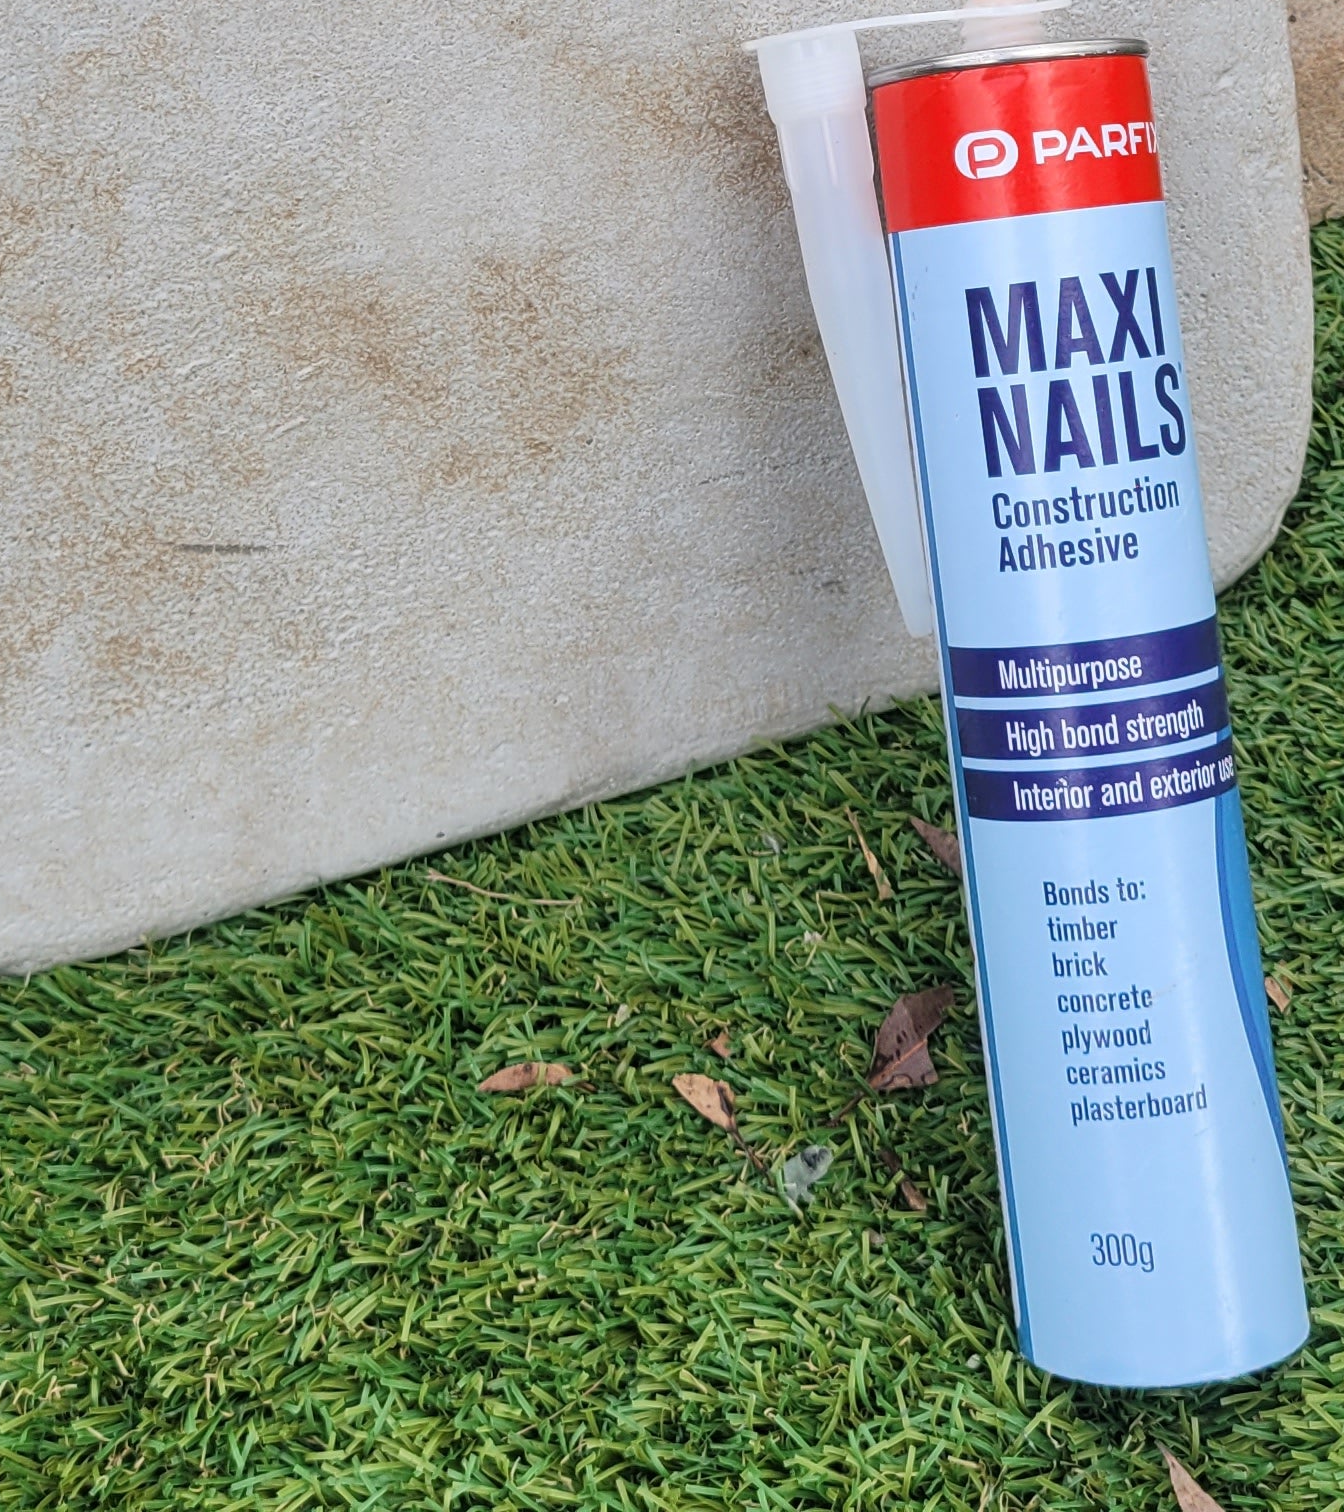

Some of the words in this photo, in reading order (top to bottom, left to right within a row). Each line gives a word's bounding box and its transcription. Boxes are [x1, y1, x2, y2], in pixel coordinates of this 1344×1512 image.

[964, 267, 1166, 378] MAXI
[978, 364, 1187, 478] NAILS
[992, 477, 1181, 530] Construction
[998, 526, 1140, 573] Adhesive
[998, 654, 1143, 693] Multipurpose
[1006, 721, 1055, 757] High
[1061, 715, 1119, 750] bond
[1126, 699, 1205, 744] strength
[1013, 778, 1094, 811] Interior
[1100, 771, 1144, 806] and
[1149, 759, 1216, 799] exterior
[1218, 754, 1235, 783] use
[1043, 879, 1110, 906] Bonds
[1116, 877, 1147, 901] to:
[1047, 916, 1118, 942] timber
[1052, 951, 1108, 977] brick
[1057, 984, 1153, 1013] concrete
[1061, 1019, 1152, 1055] plywood
[1067, 1057, 1166, 1085] ceramics
[1071, 1083, 1207, 1127] plasterboard
[1090, 1232, 1155, 1273] 300g
